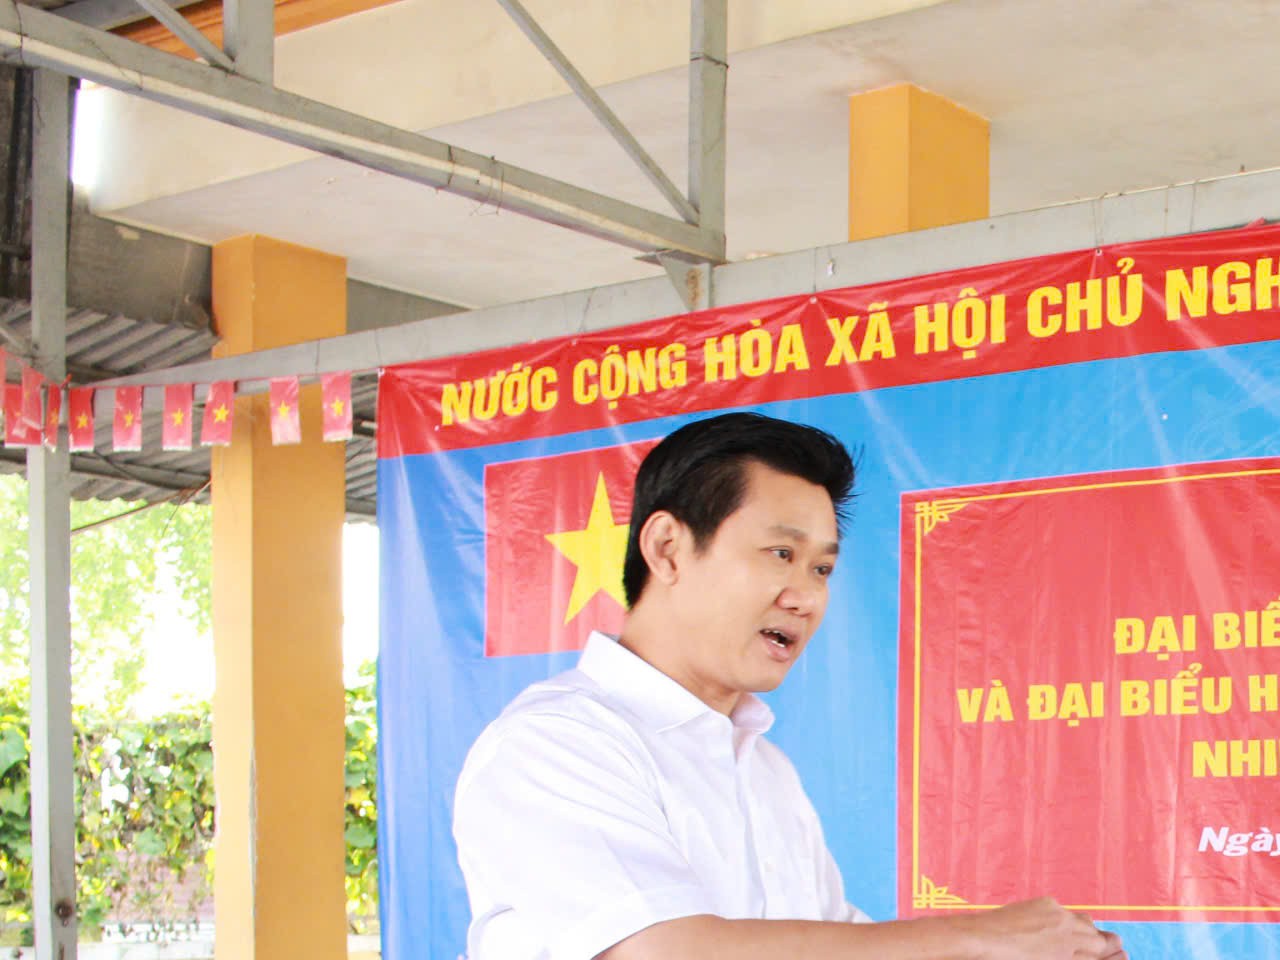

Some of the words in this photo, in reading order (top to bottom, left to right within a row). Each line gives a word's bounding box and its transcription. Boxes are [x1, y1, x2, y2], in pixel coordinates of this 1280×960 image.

[440, 362, 560, 427] NƯỚC
[571, 343, 689, 409] CỘNG
[703, 319, 807, 383] HÒA
[824, 301, 897, 367] XÃ
[913, 298, 1006, 360] HỘI
[1026, 256, 1144, 339] CHỦ
[1113, 614, 1197, 660] ĐẠI
[957, 679, 1014, 723] VÀ
[1027, 681, 1105, 727] ĐẠI
[1120, 662, 1233, 717] BIỂU
